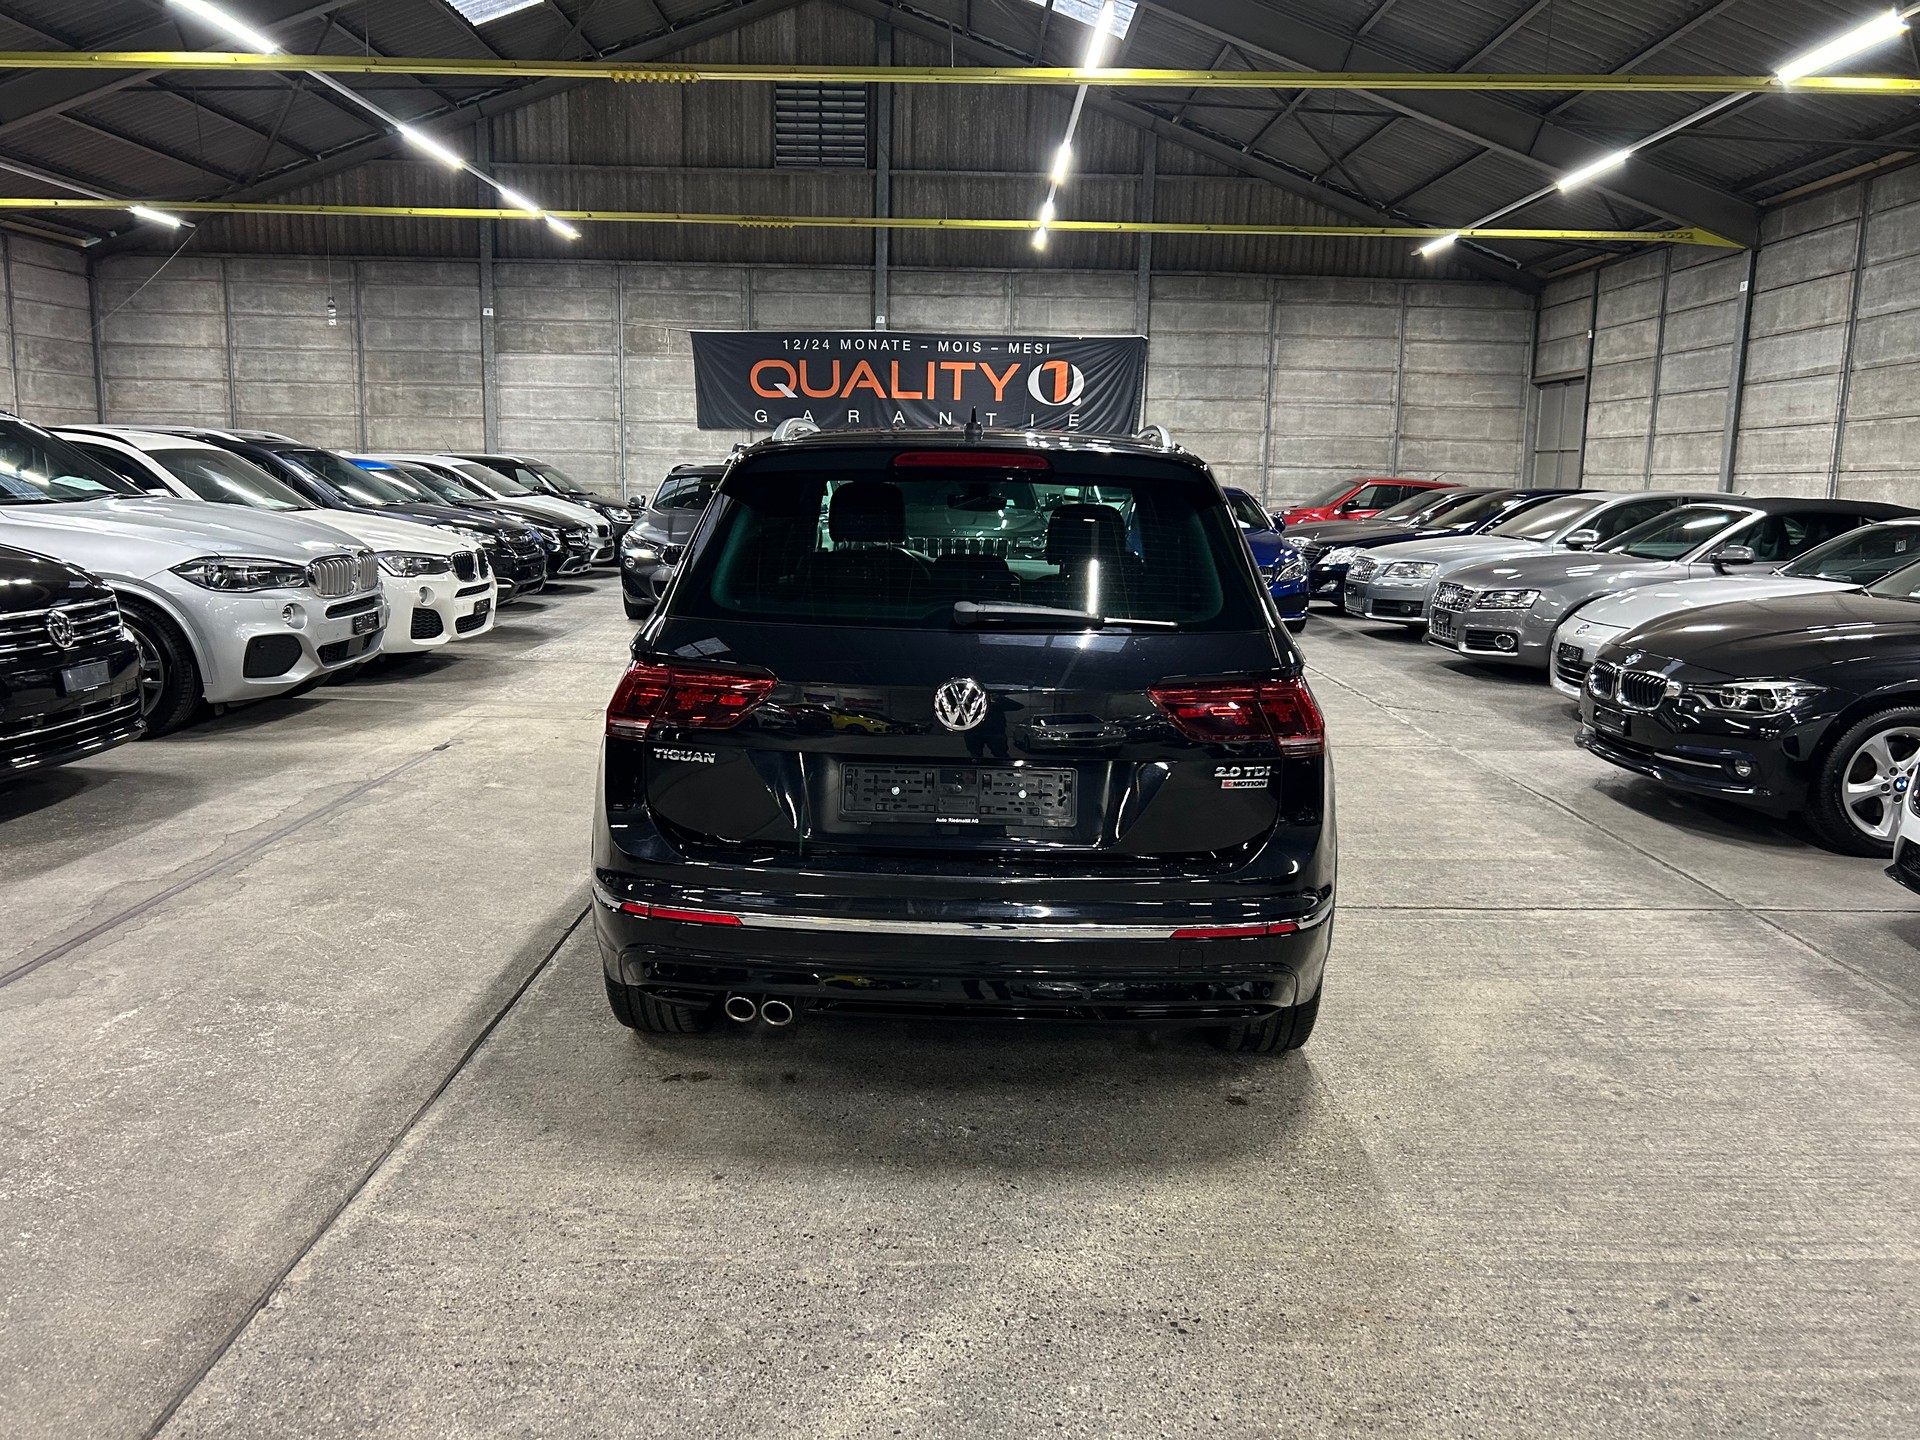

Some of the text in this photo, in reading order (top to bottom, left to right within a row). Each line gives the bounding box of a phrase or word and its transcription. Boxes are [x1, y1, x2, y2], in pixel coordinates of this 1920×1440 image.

[782, 338, 830, 350] 12/24
[840, 339, 911, 351] MONATE
[937, 340, 982, 353] MOIS
[1008, 342, 1051, 355] MESI
[750, 359, 1021, 402] QUALITY
[754, 409, 1080, 428] GARANTIE
[653, 747, 716, 764] TIGUAN
[1213, 765, 1272, 778] 2.0 TDI
